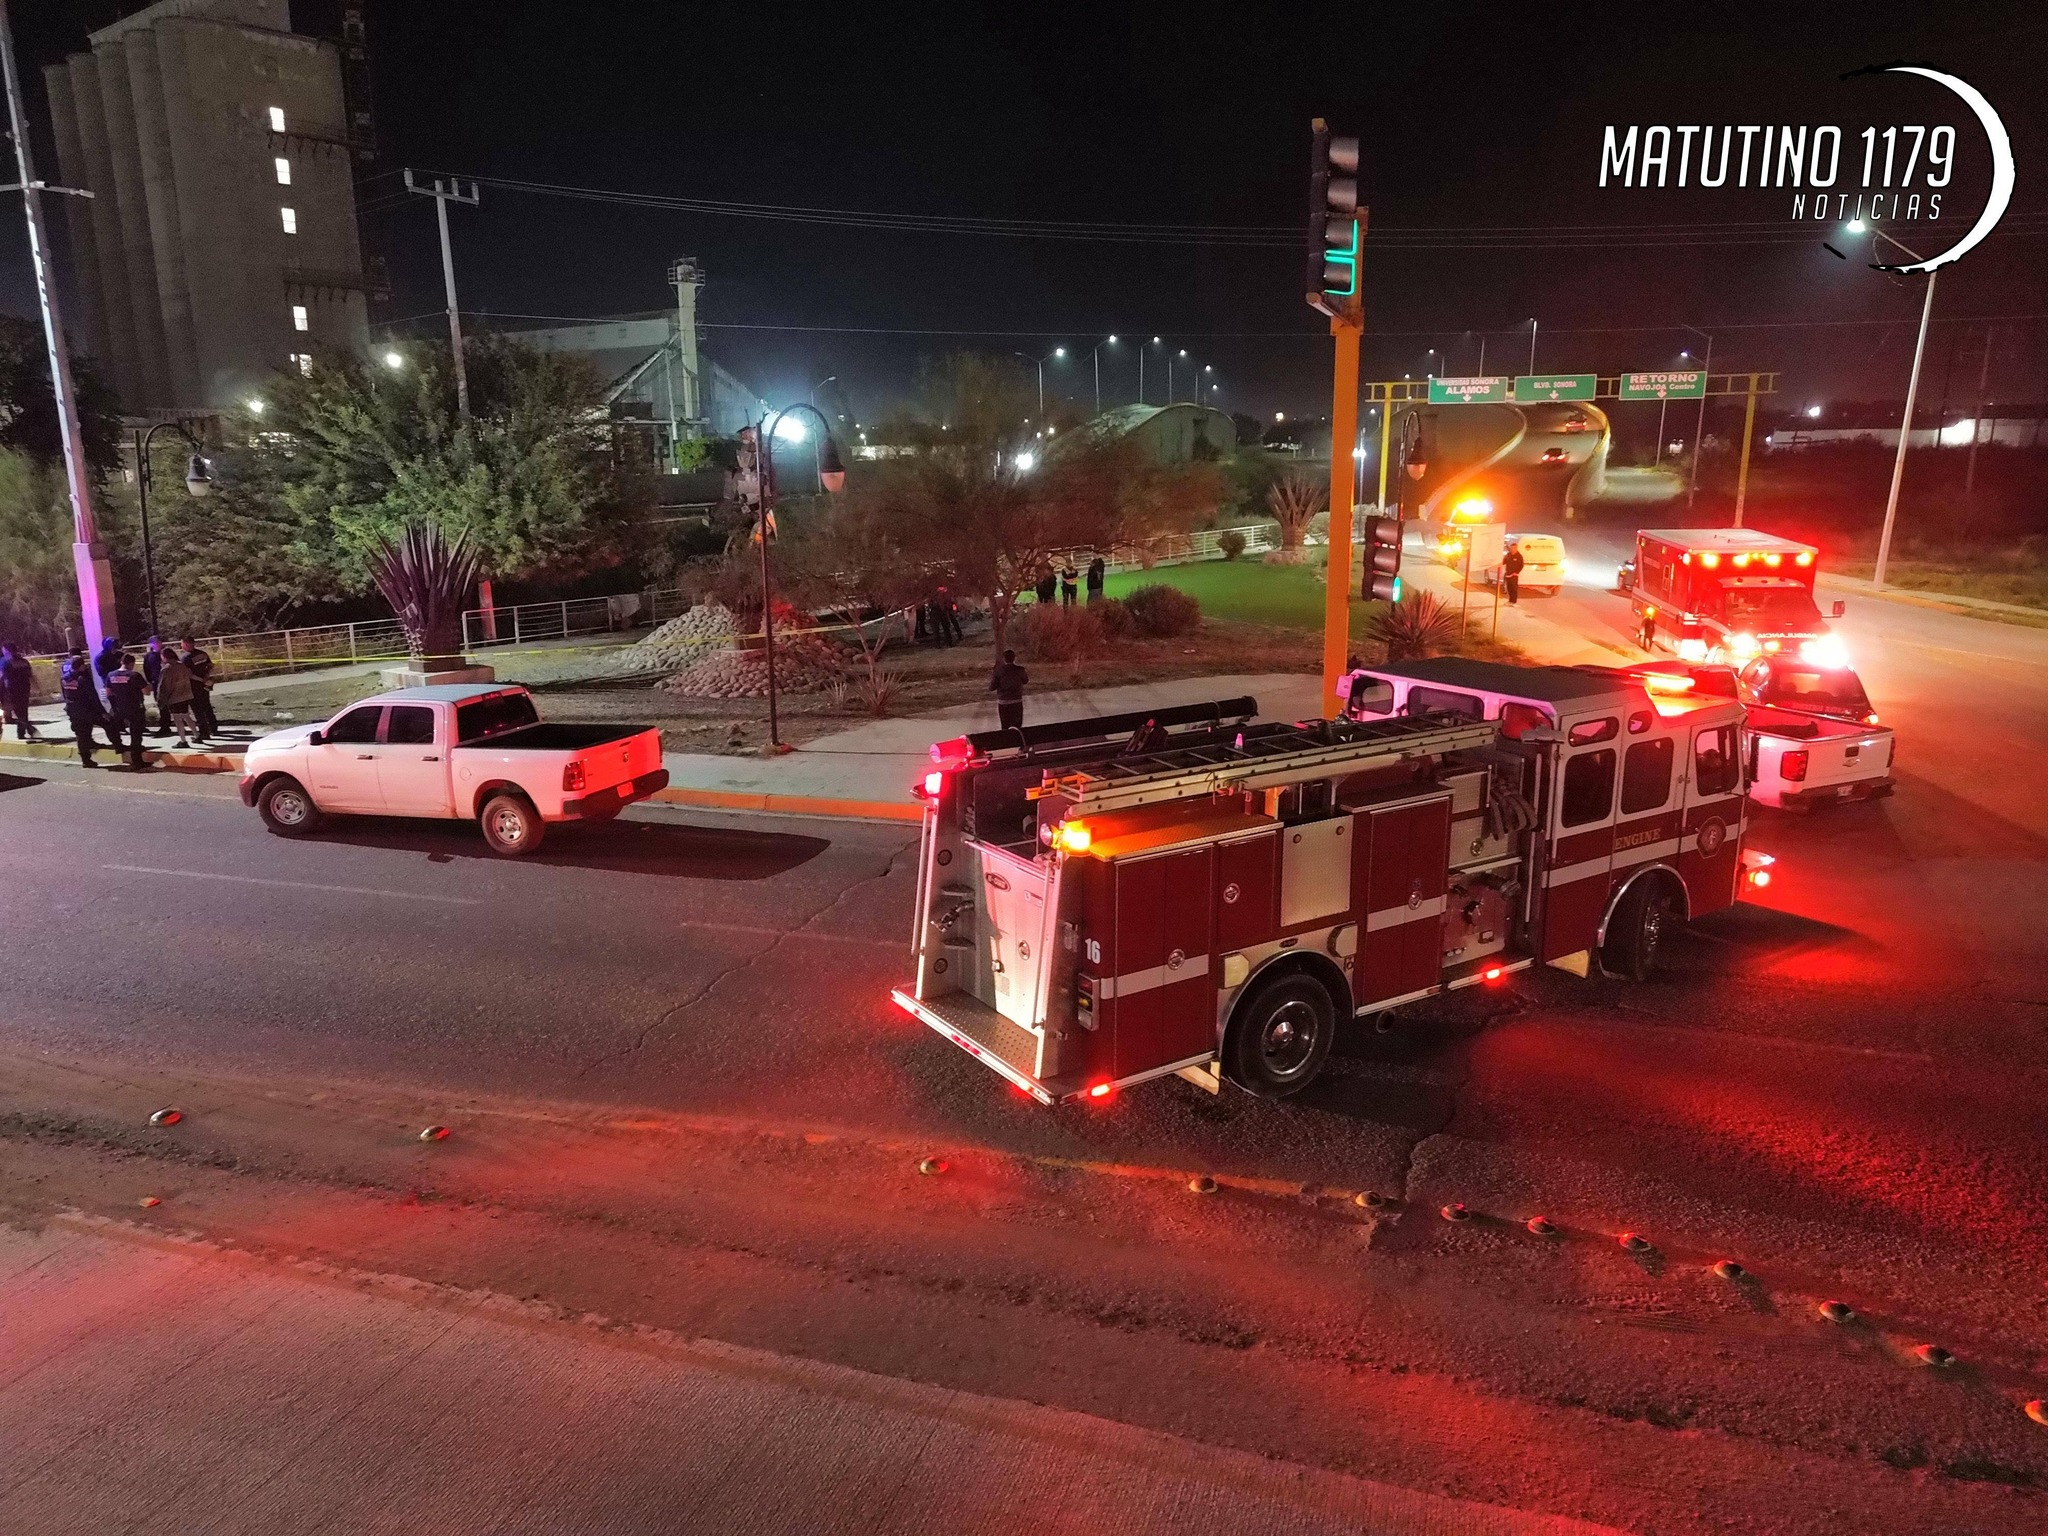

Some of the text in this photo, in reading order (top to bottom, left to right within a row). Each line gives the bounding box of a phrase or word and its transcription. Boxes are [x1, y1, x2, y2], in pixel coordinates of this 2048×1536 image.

[1470, 378, 1500, 386] SONORA
[1629, 373, 1698, 384] RETORNO
[1445, 385, 1490, 395] ALAMOS
[1628, 383, 1667, 391] NAVOJOA
[1614, 828, 1661, 850] ENGINE
[1085, 938, 1100, 964] 16
